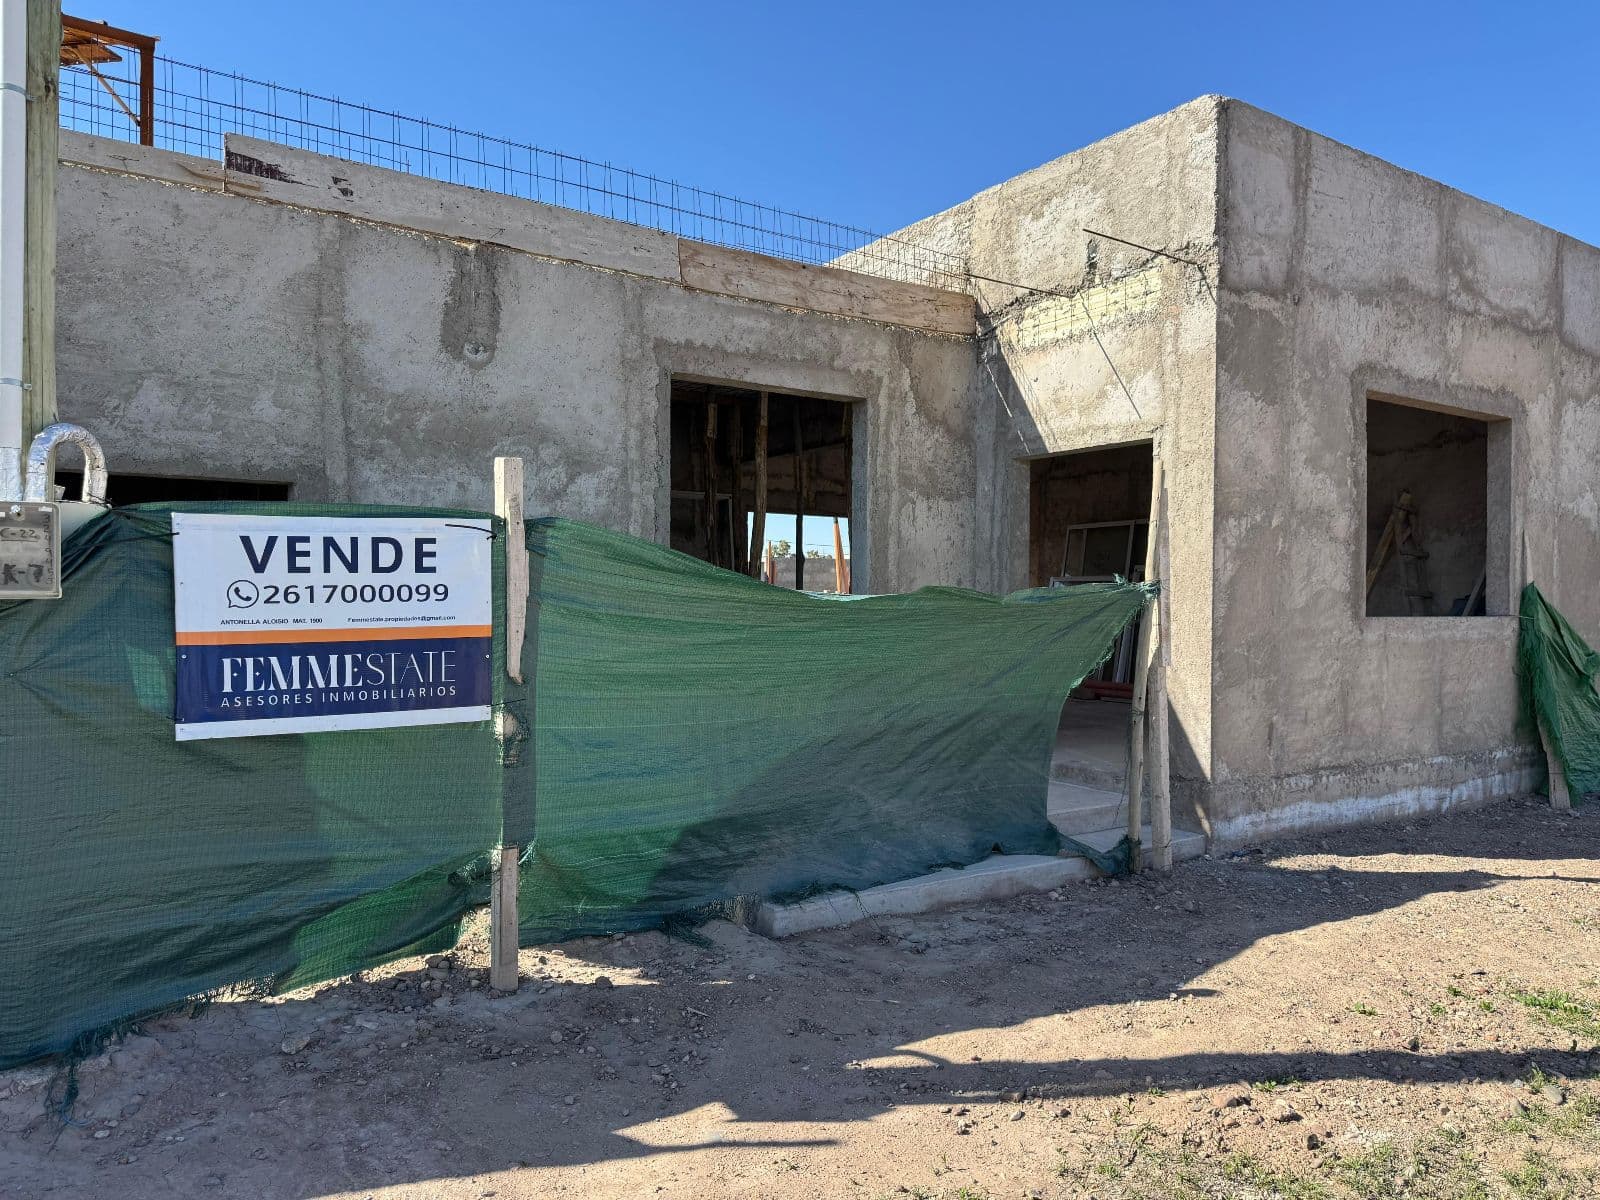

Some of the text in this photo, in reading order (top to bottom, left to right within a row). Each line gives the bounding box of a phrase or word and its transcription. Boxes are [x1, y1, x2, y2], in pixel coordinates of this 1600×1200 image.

[239, 535, 437, 574] VENDE
[263, 583, 449, 605] 2617000099
[221, 650, 456, 693] FEMMESTATE
[220, 685, 457, 708] ASESORES INMOBILIARIOS
